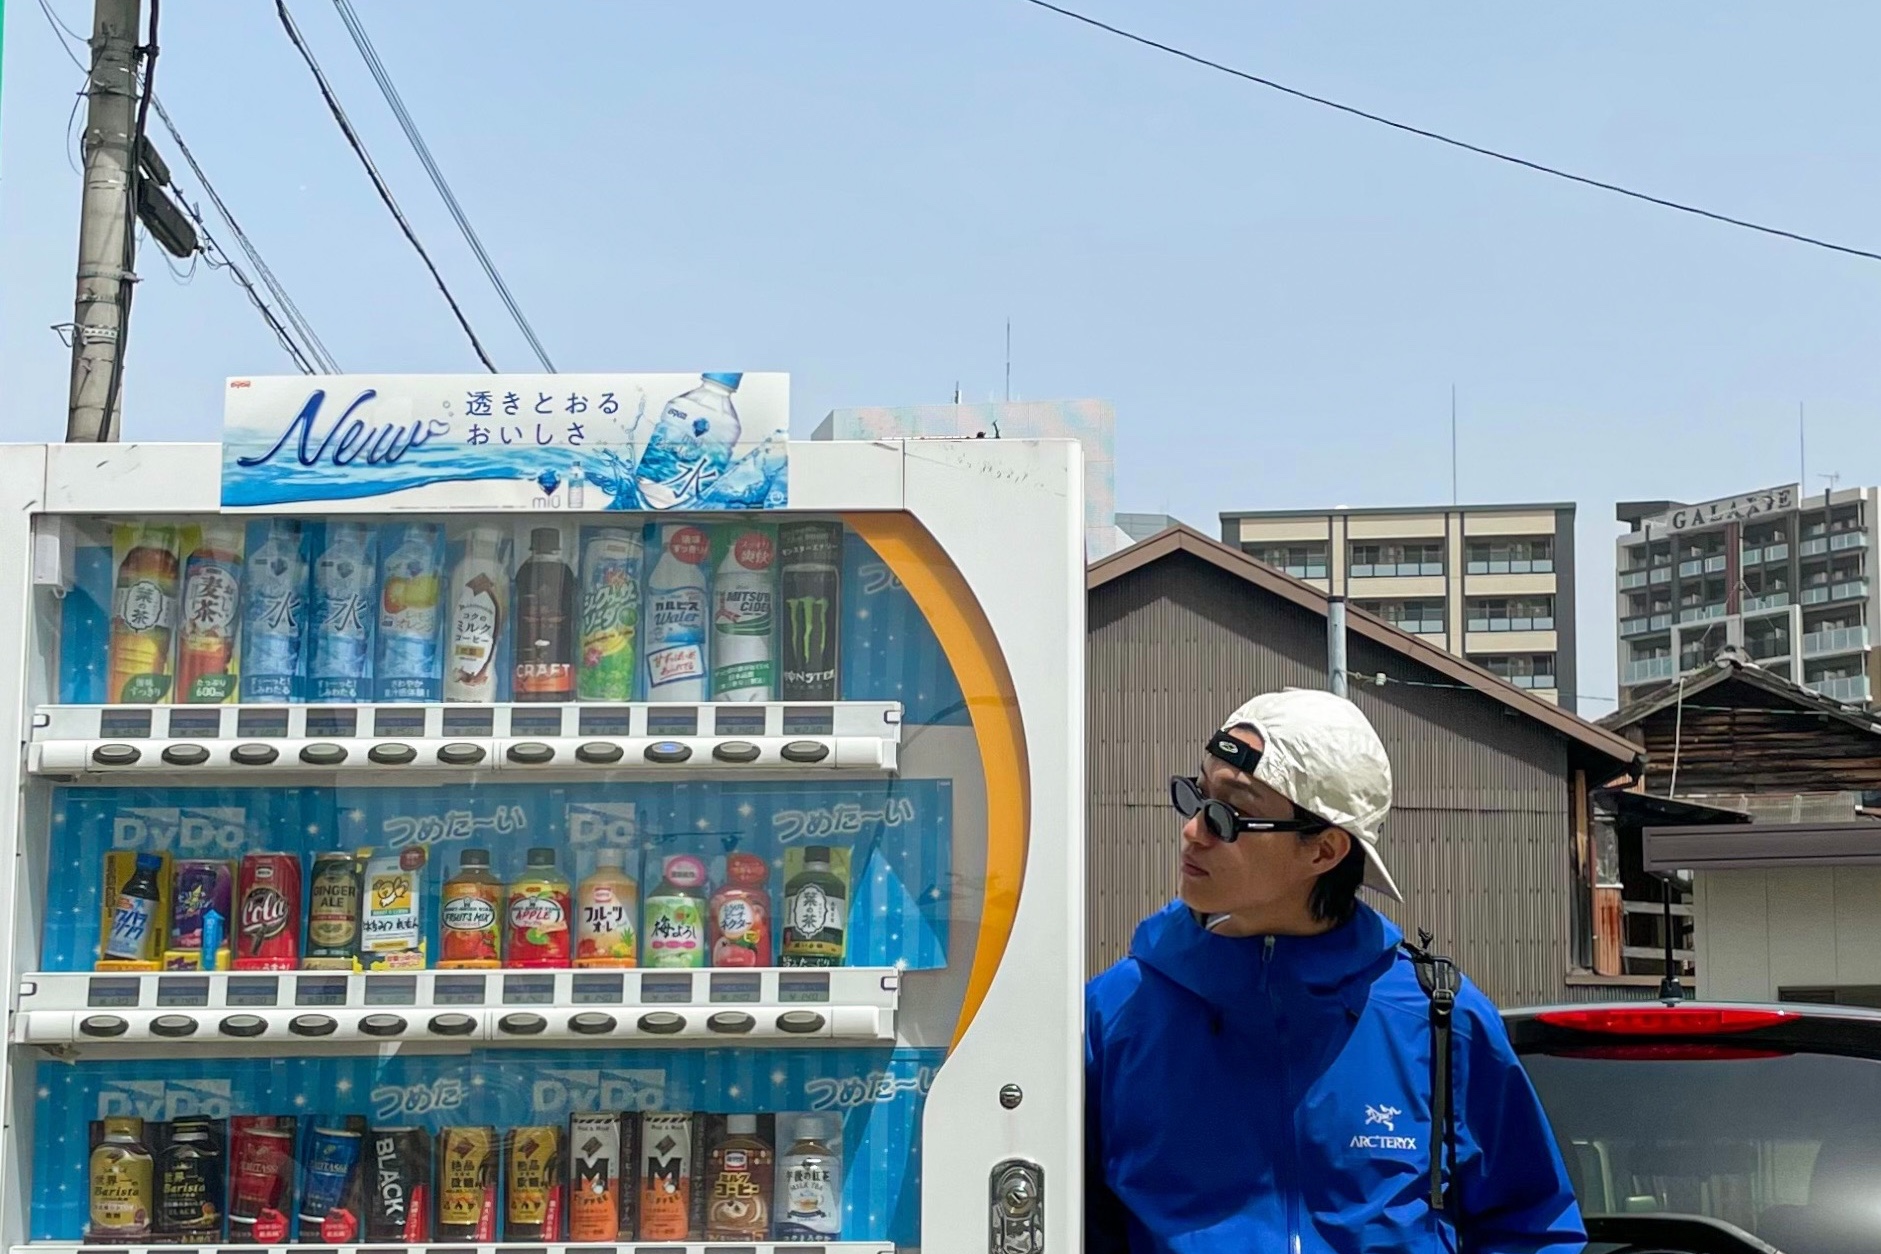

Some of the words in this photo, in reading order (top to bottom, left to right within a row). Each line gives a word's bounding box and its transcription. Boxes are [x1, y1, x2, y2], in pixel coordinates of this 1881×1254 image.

[465, 389, 621, 417] 透きとおる
[237, 389, 449, 467] New
[467, 421, 588, 446] おいしさ
[660, 457, 717, 500] 水
[195, 575, 223, 622] 麦茶
[259, 591, 301, 628] 水
[326, 594, 368, 631] 水
[463, 612, 487, 621] コクの
[455, 634, 490, 644] コーヒー
[457, 620, 491, 634] ミルク
[516, 663, 571, 678] CRAFT
[113, 816, 246, 850] DyDo
[313, 885, 356, 897] GINGER
[320, 898, 345, 908] ALE
[243, 891, 286, 926] Cola
[516, 909, 551, 920] APPLE
[584, 906, 623, 922] フルーツ
[376, 1137, 405, 1217] BLACK
[94, 1186, 140, 1196] Barista
